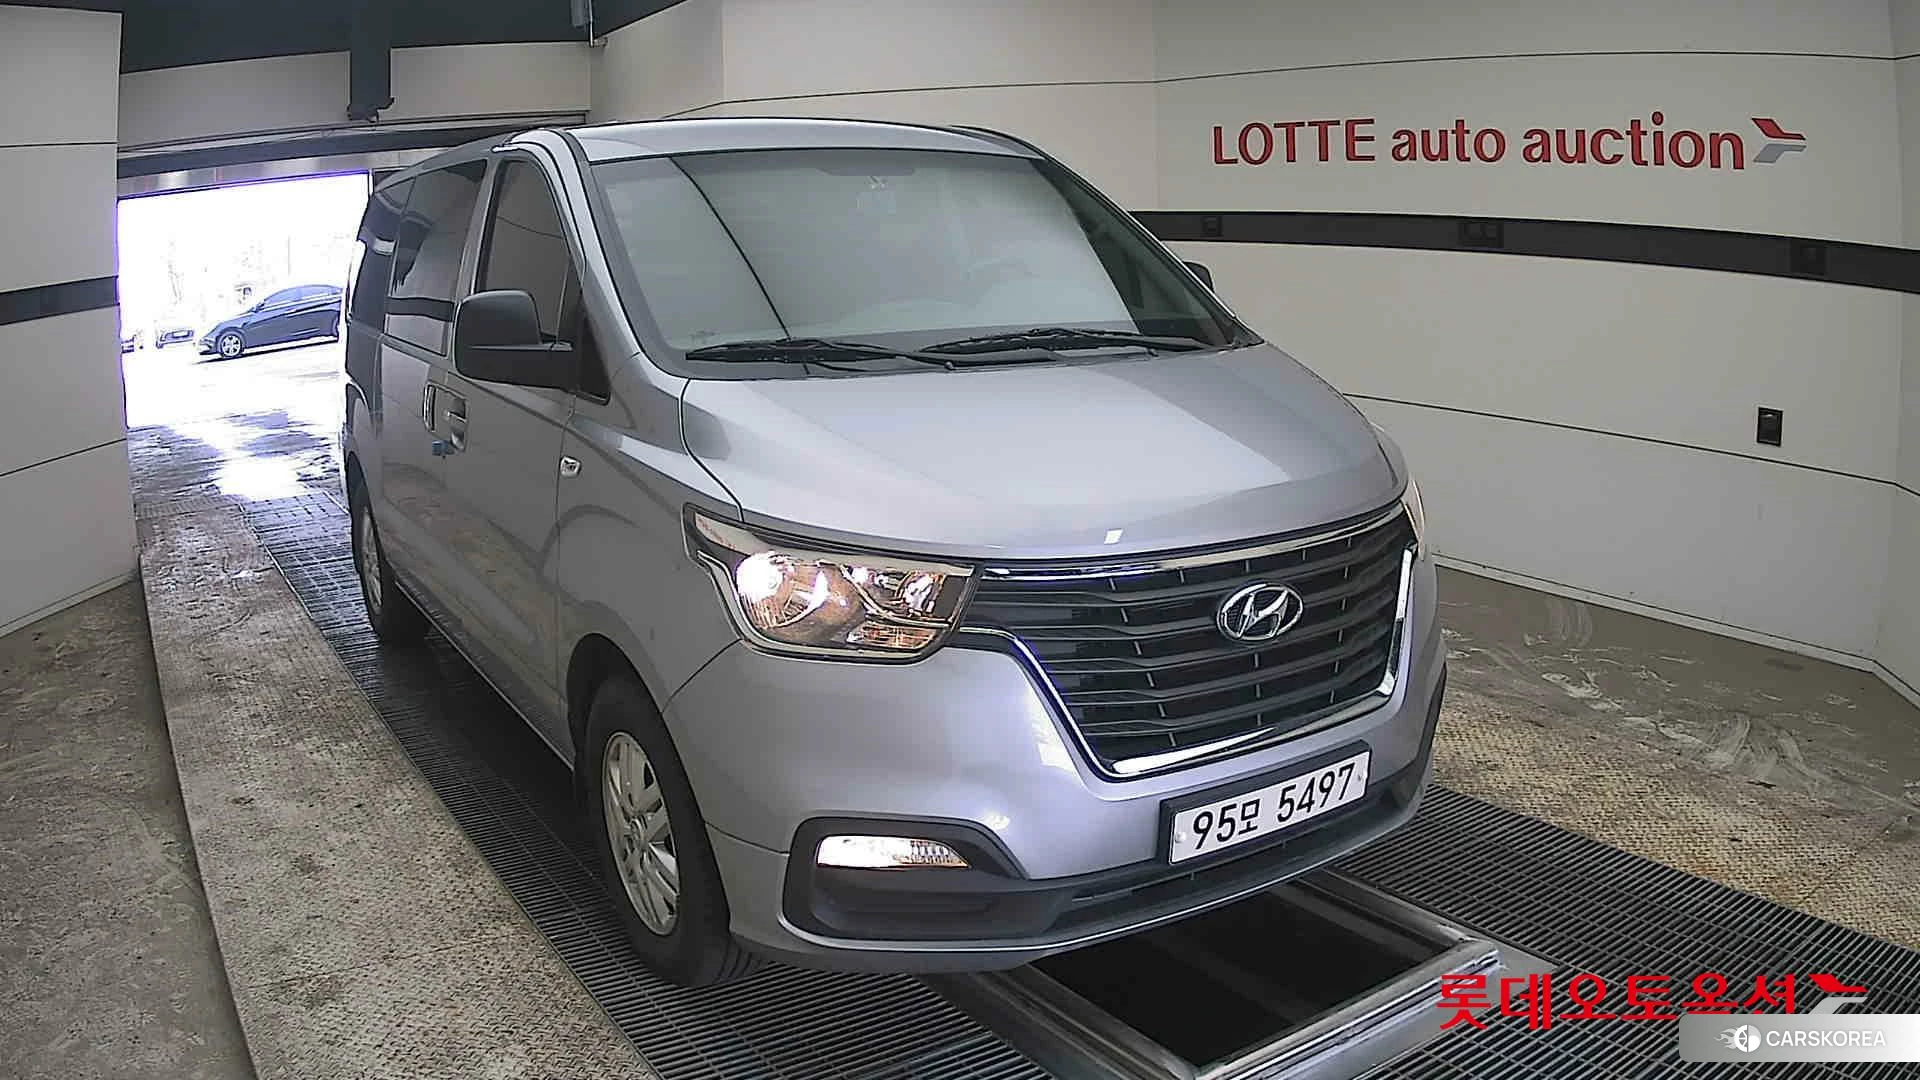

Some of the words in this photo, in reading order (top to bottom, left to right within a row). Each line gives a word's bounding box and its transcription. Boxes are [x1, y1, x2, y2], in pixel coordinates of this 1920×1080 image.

[1213, 118, 1376, 165] LOTTE
[1391, 119, 1507, 163] auto
[1522, 111, 1745, 171] auction
[1192, 797, 1261, 850] 95모
[1276, 761, 1356, 823] 5497
